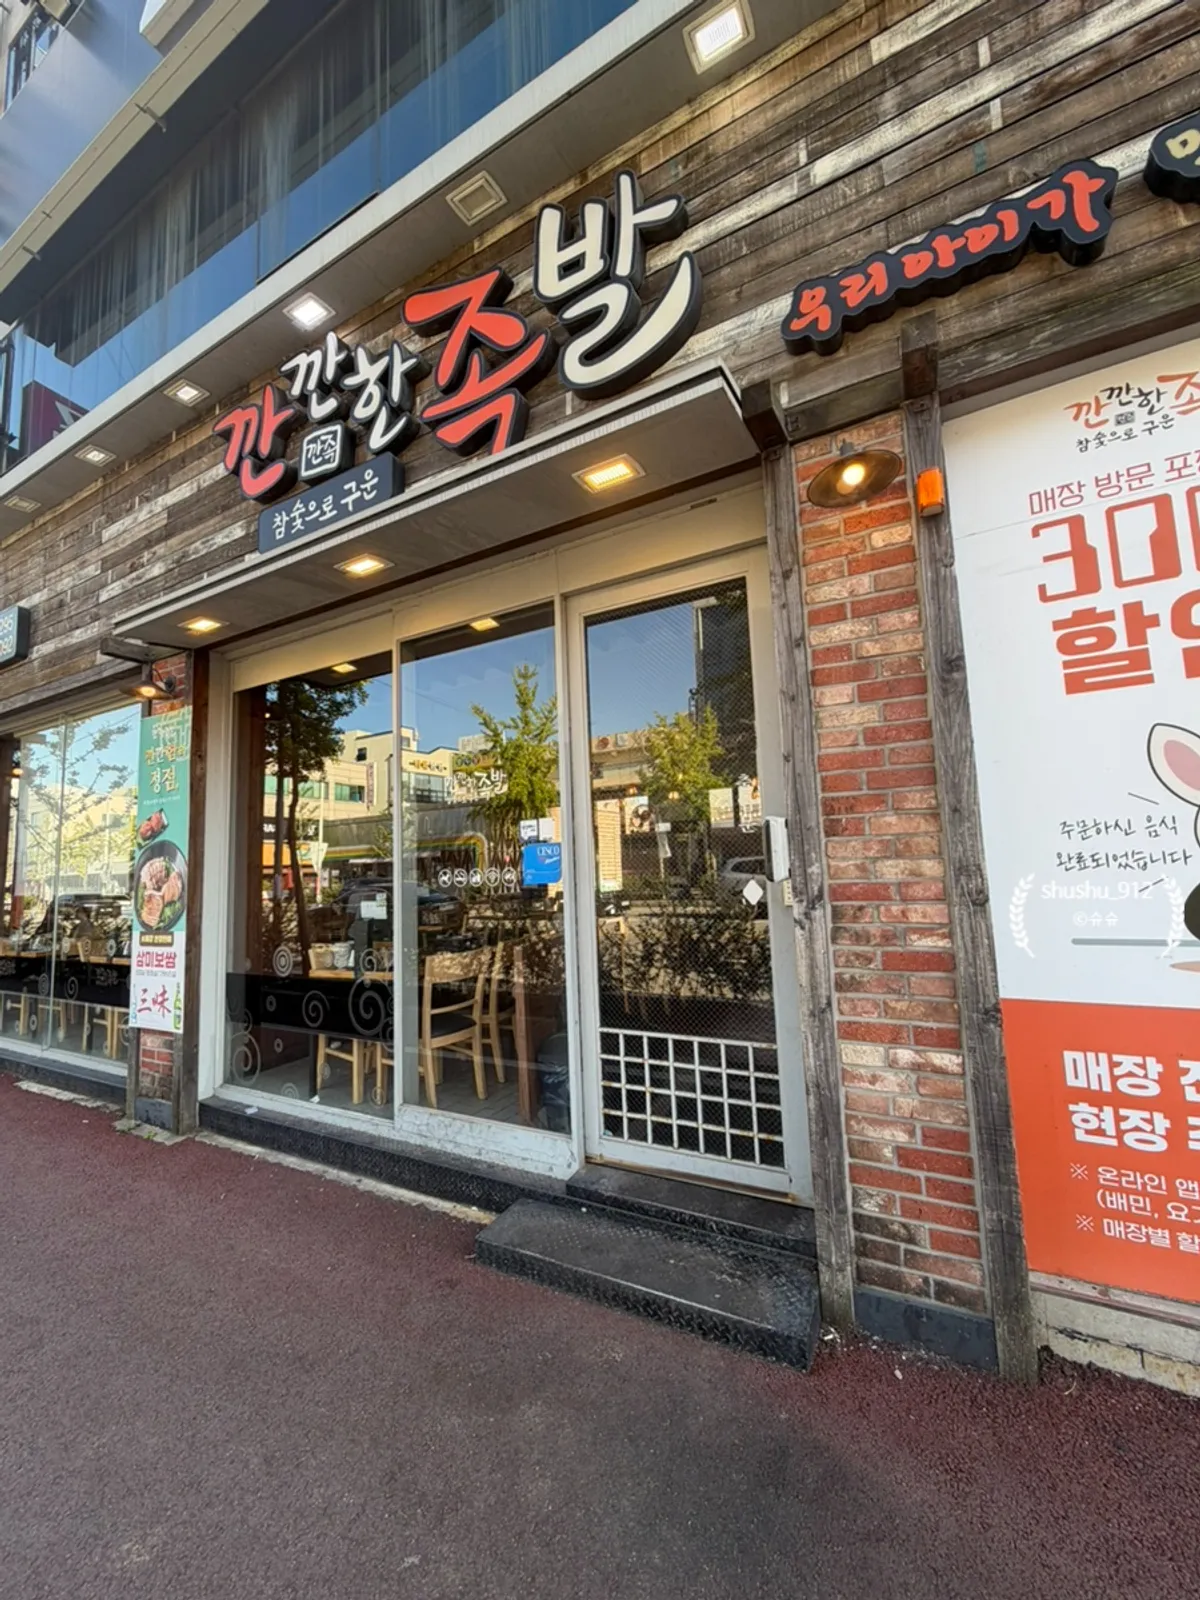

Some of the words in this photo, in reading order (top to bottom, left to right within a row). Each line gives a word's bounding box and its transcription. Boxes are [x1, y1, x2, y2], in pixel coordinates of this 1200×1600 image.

[306, 433, 336, 464] 깐족
[1076, 427, 1138, 453] 참숯으로
[1141, 413, 1175, 435] 구운
[271, 496, 338, 540] 참숯으로
[340, 468, 380, 512] 구운
[1028, 480, 1086, 516] 매장
[1095, 462, 1156, 499] 방문
[1031, 484, 1200, 603] 30
[1059, 818, 1136, 841] 주문하신
[1144, 815, 1179, 838] 음식
[1056, 848, 1193, 872] 완료되었습니다
[136, 951, 177, 969] 삼미보쌈
[137, 984, 171, 1019] 三味
[1062, 1049, 1164, 1098] 매장
[1067, 1102, 1171, 1153] 현장
[1096, 1166, 1168, 1196] 온라인
[1096, 1189, 1159, 1219] (배민,
[1102, 1218, 1171, 1249] 매장별
